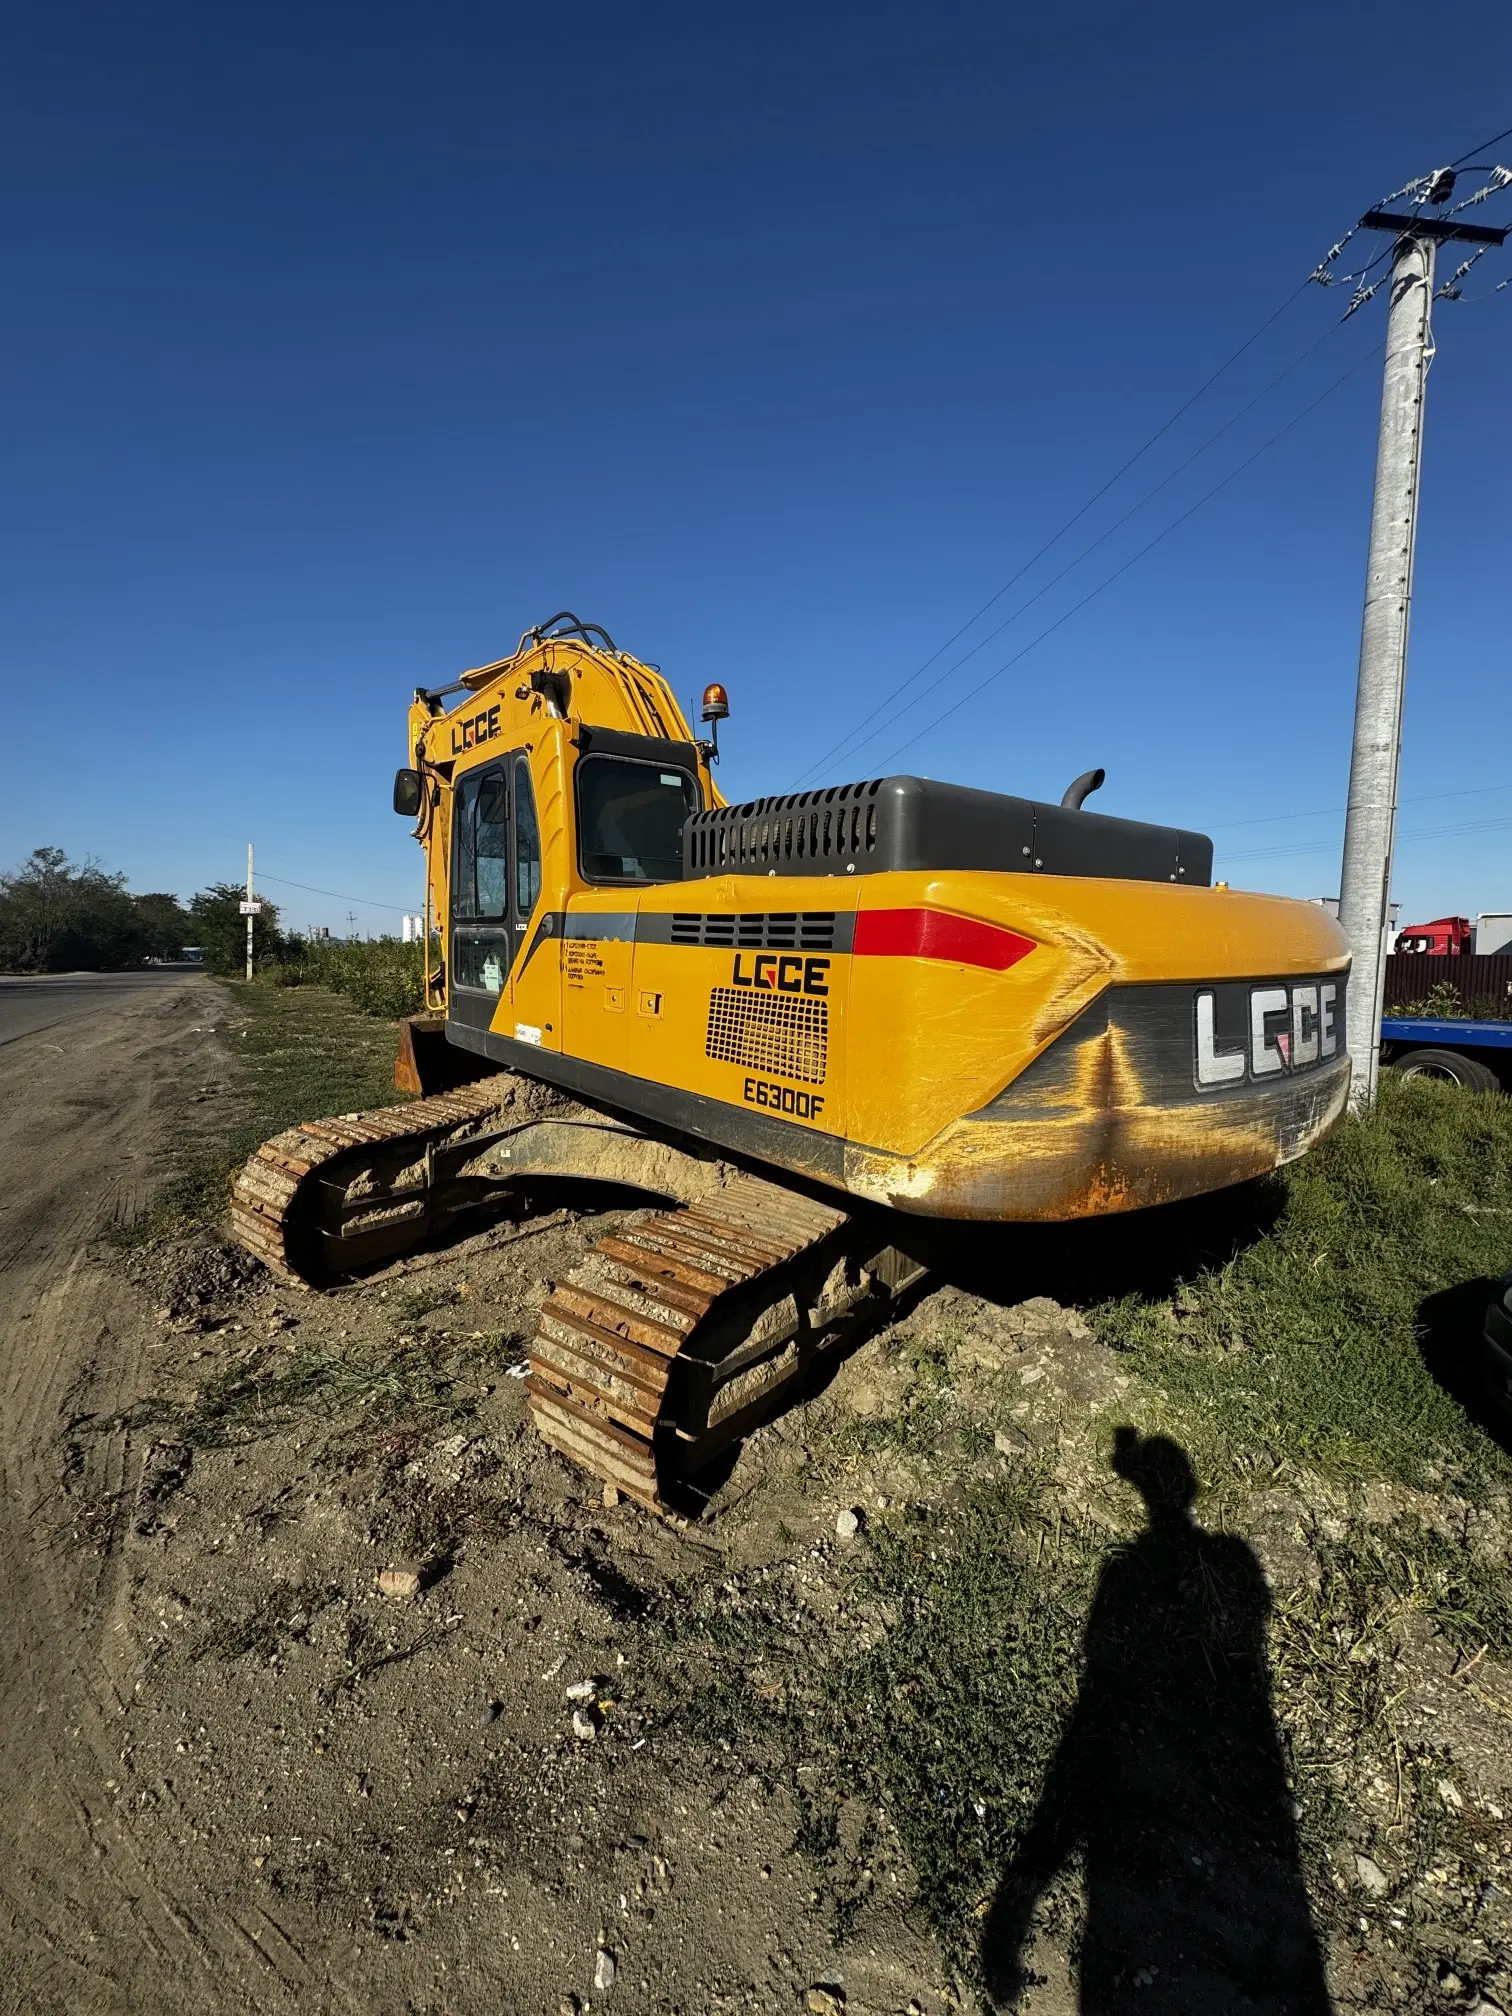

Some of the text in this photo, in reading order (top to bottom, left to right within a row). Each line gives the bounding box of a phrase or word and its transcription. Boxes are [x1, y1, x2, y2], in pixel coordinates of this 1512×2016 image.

[451, 704, 501, 756] LGCE
[733, 953, 831, 996] LGCE
[1197, 984, 1337, 1084] LGCE
[743, 1077, 825, 1121] E6300F
